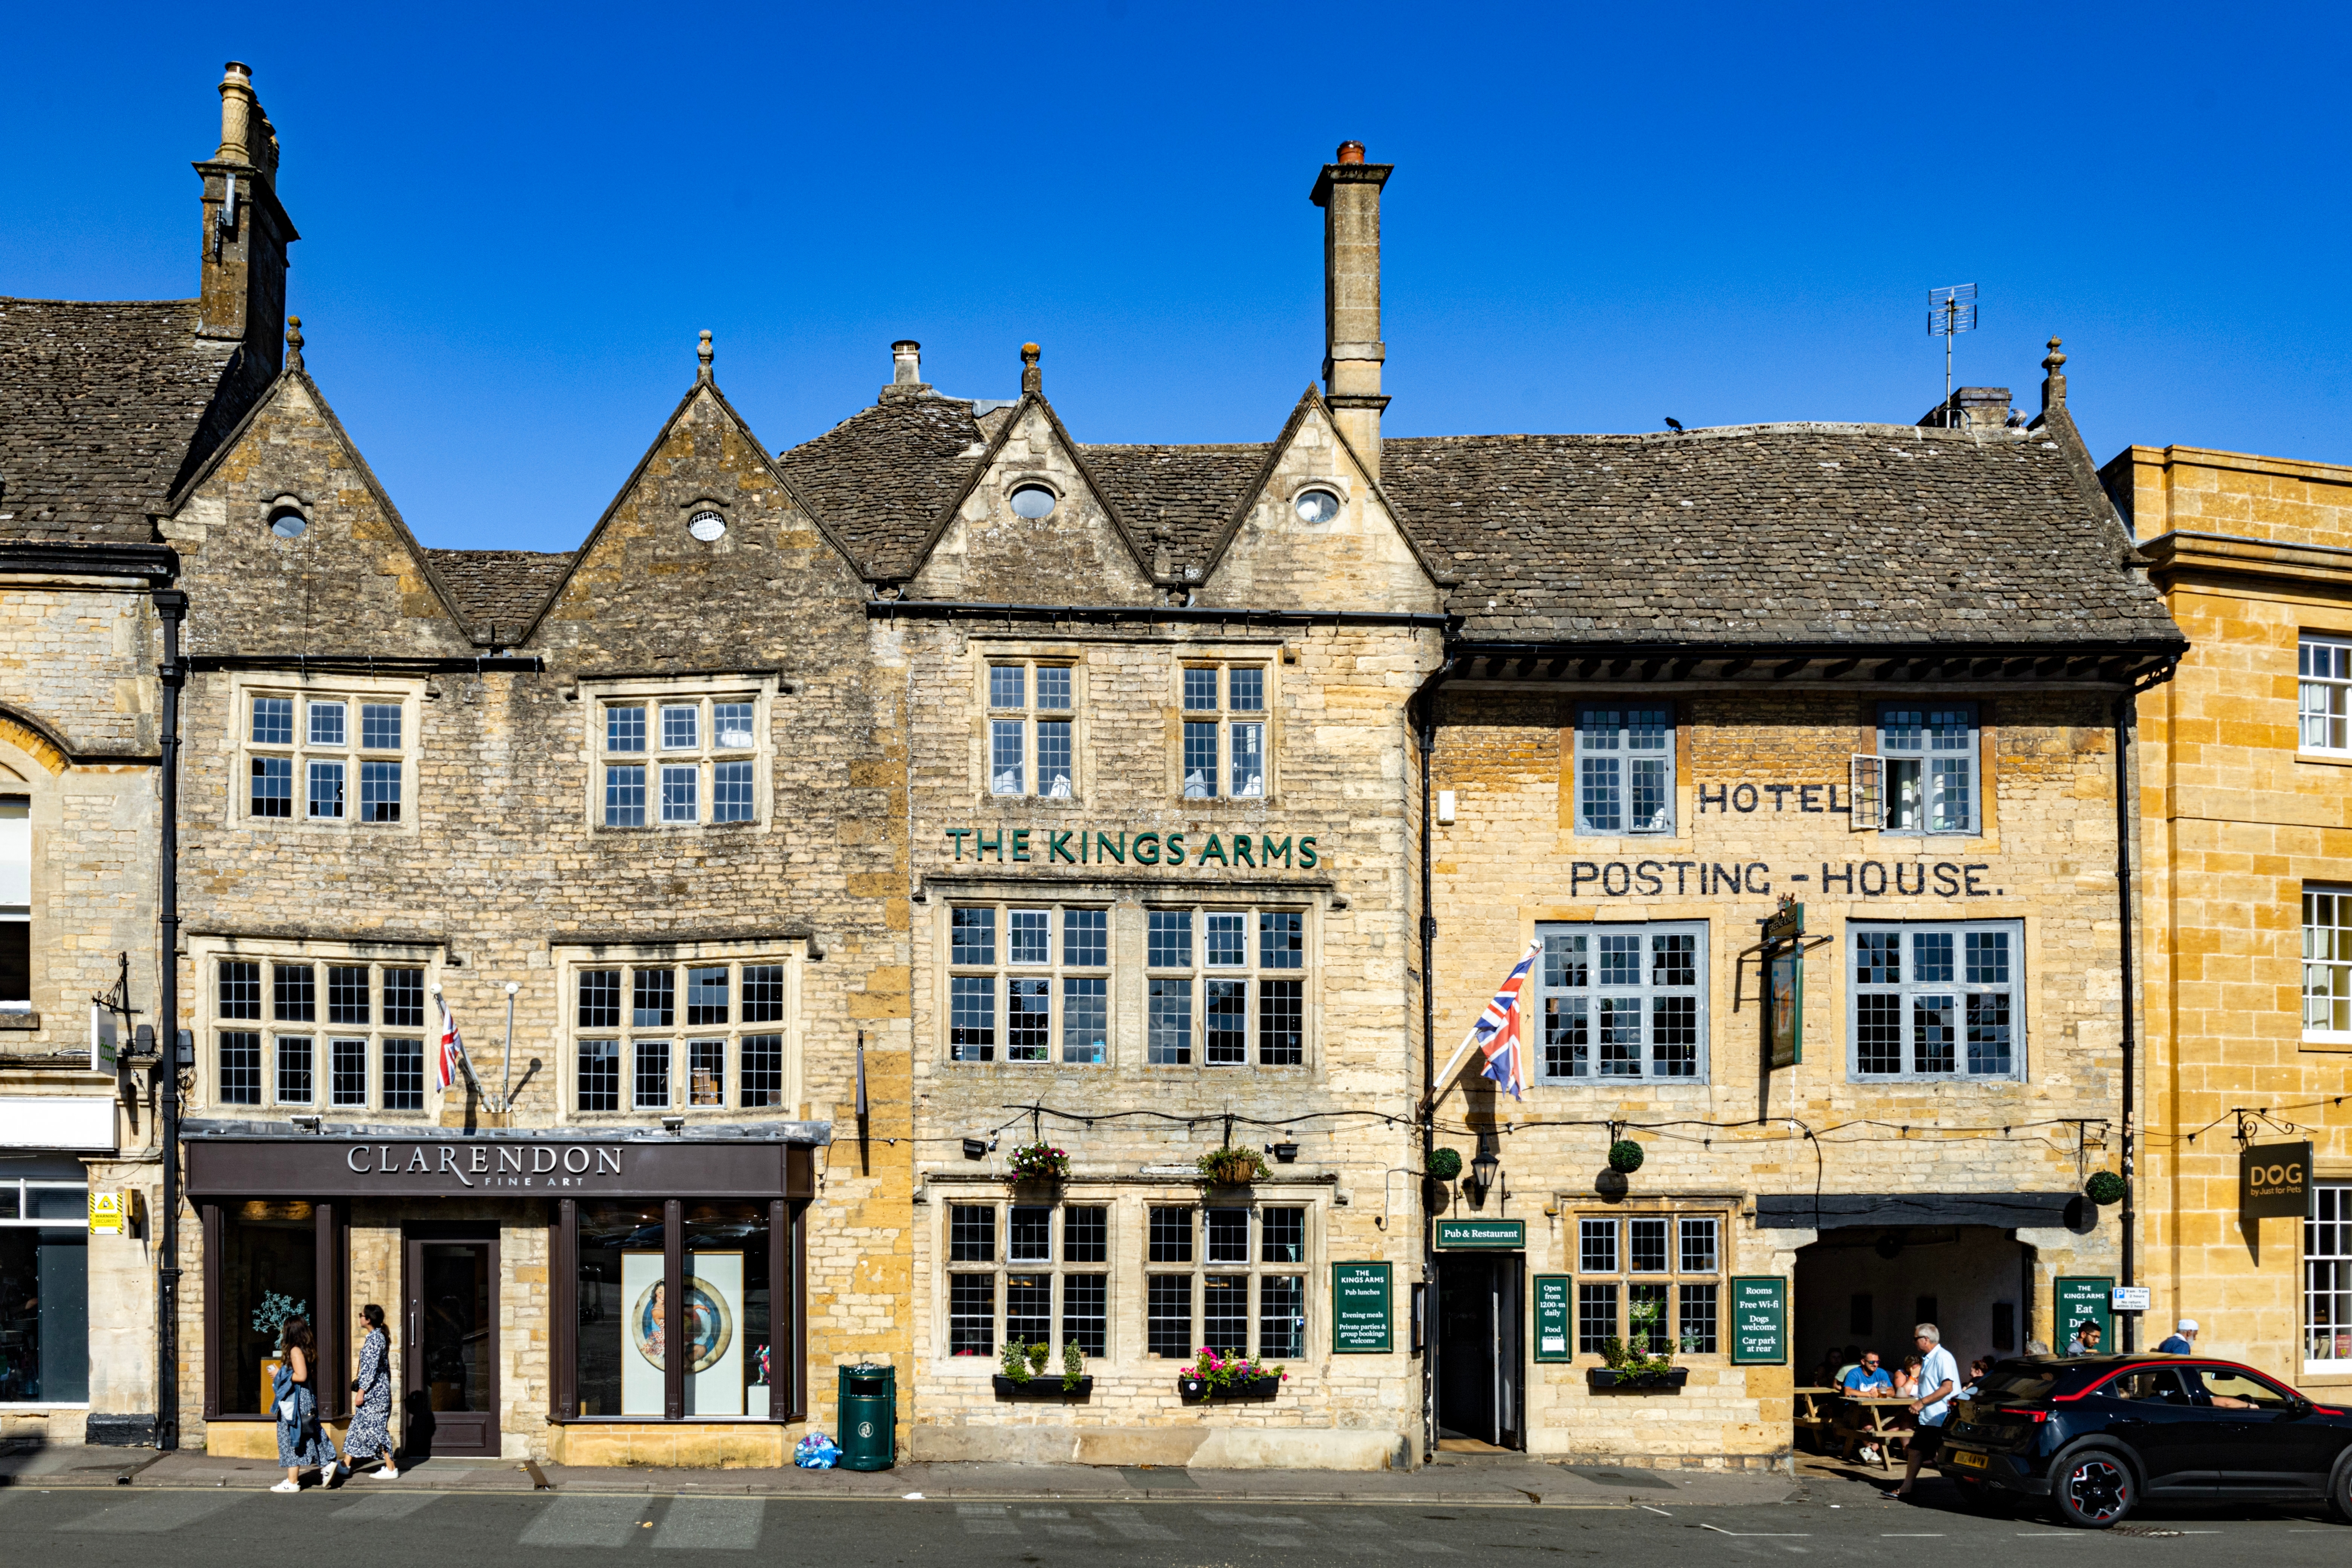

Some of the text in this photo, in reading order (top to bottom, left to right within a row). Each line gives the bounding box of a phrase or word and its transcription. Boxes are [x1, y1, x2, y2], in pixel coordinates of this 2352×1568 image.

[1699, 783, 1852, 813] HOTEL
[945, 828, 1318, 868] THE KINGS ARMS
[1571, 860, 1771, 897] POSTING
[1822, 861, 2003, 897] HOUSE.
[1768, 913, 1796, 932] GREENE KING
[347, 1145, 623, 1187] CLARENDON
[2251, 1163, 2302, 1186] DOG
[485, 1177, 583, 1186] FINE ART
[2251, 1188, 2259, 1197] by
[2076, 1305, 2093, 1313] Eat
[1750, 1315, 1769, 1324] Dogs
[1758, 1337, 1776, 1346] park
